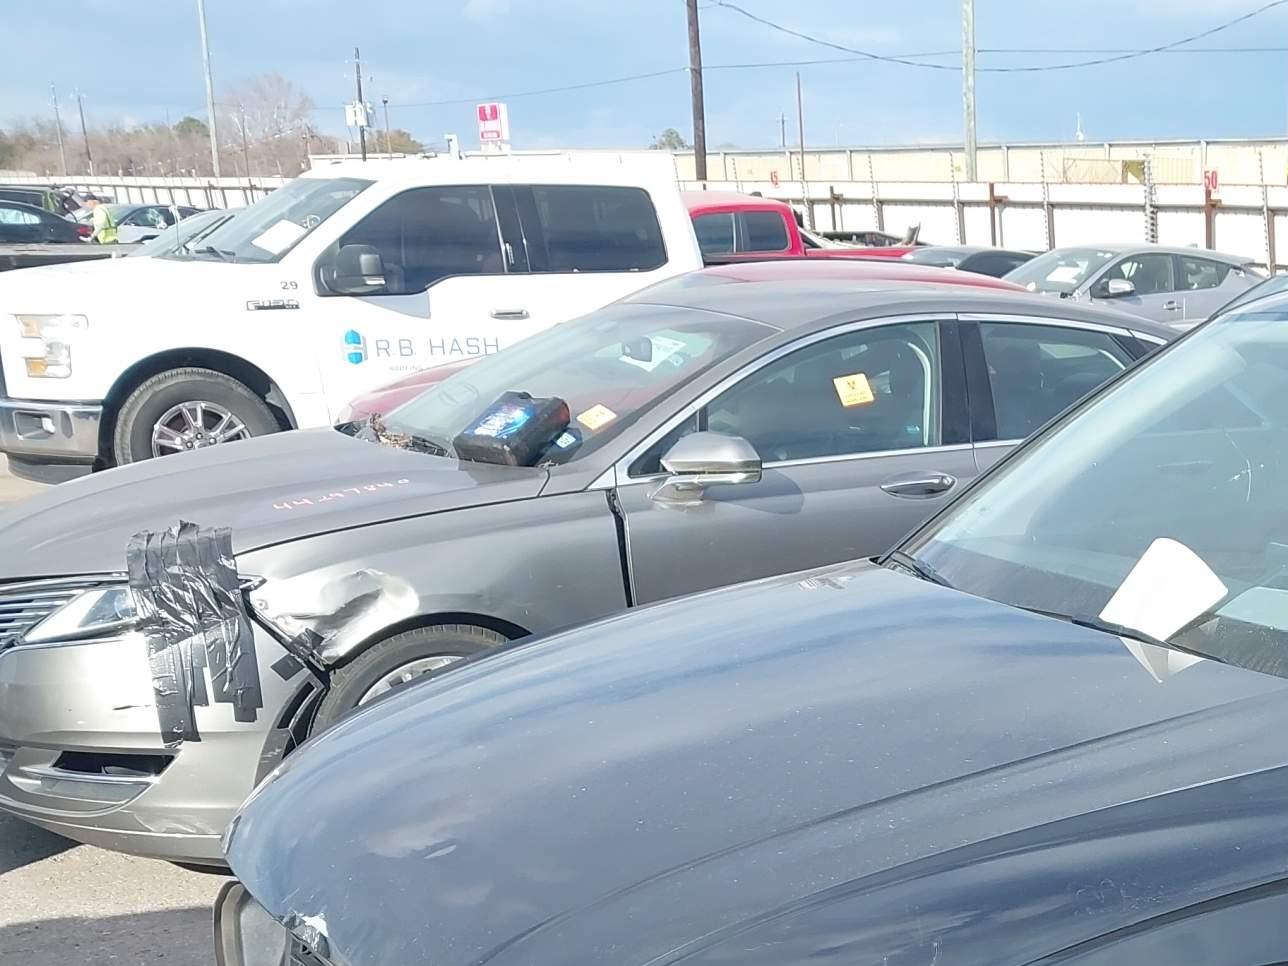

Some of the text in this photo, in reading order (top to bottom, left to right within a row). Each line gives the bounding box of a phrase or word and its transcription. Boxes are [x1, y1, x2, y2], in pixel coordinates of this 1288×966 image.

[1203, 169, 1218, 190] 50
[279, 280, 298, 290] 29
[428, 336, 499, 356] HASH
